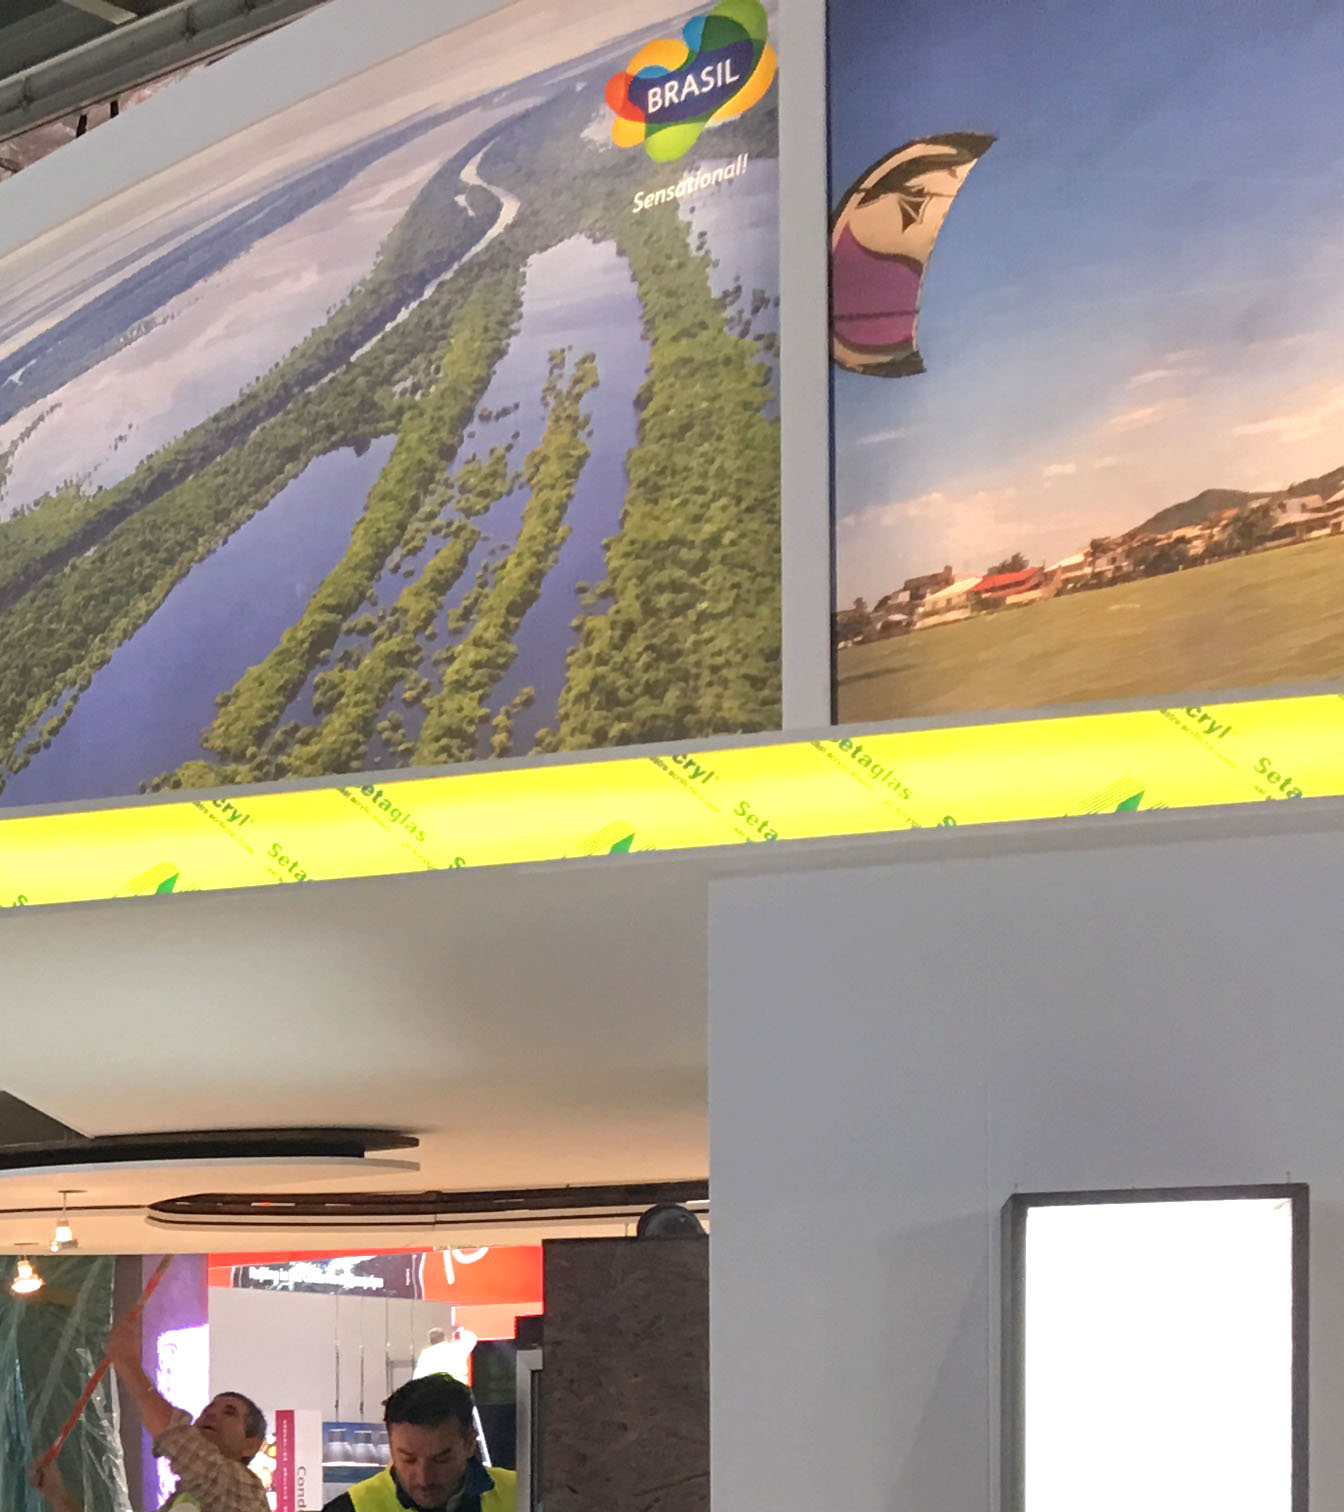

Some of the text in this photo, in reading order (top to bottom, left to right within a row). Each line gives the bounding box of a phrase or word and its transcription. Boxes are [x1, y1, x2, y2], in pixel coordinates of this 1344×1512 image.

[647, 58, 740, 114] BRASIL
[632, 152, 749, 213] Sensational!
[830, 737, 912, 801] etaglas
[359, 782, 427, 843] etaglas
[297, 1466, 307, 1512] Cond
